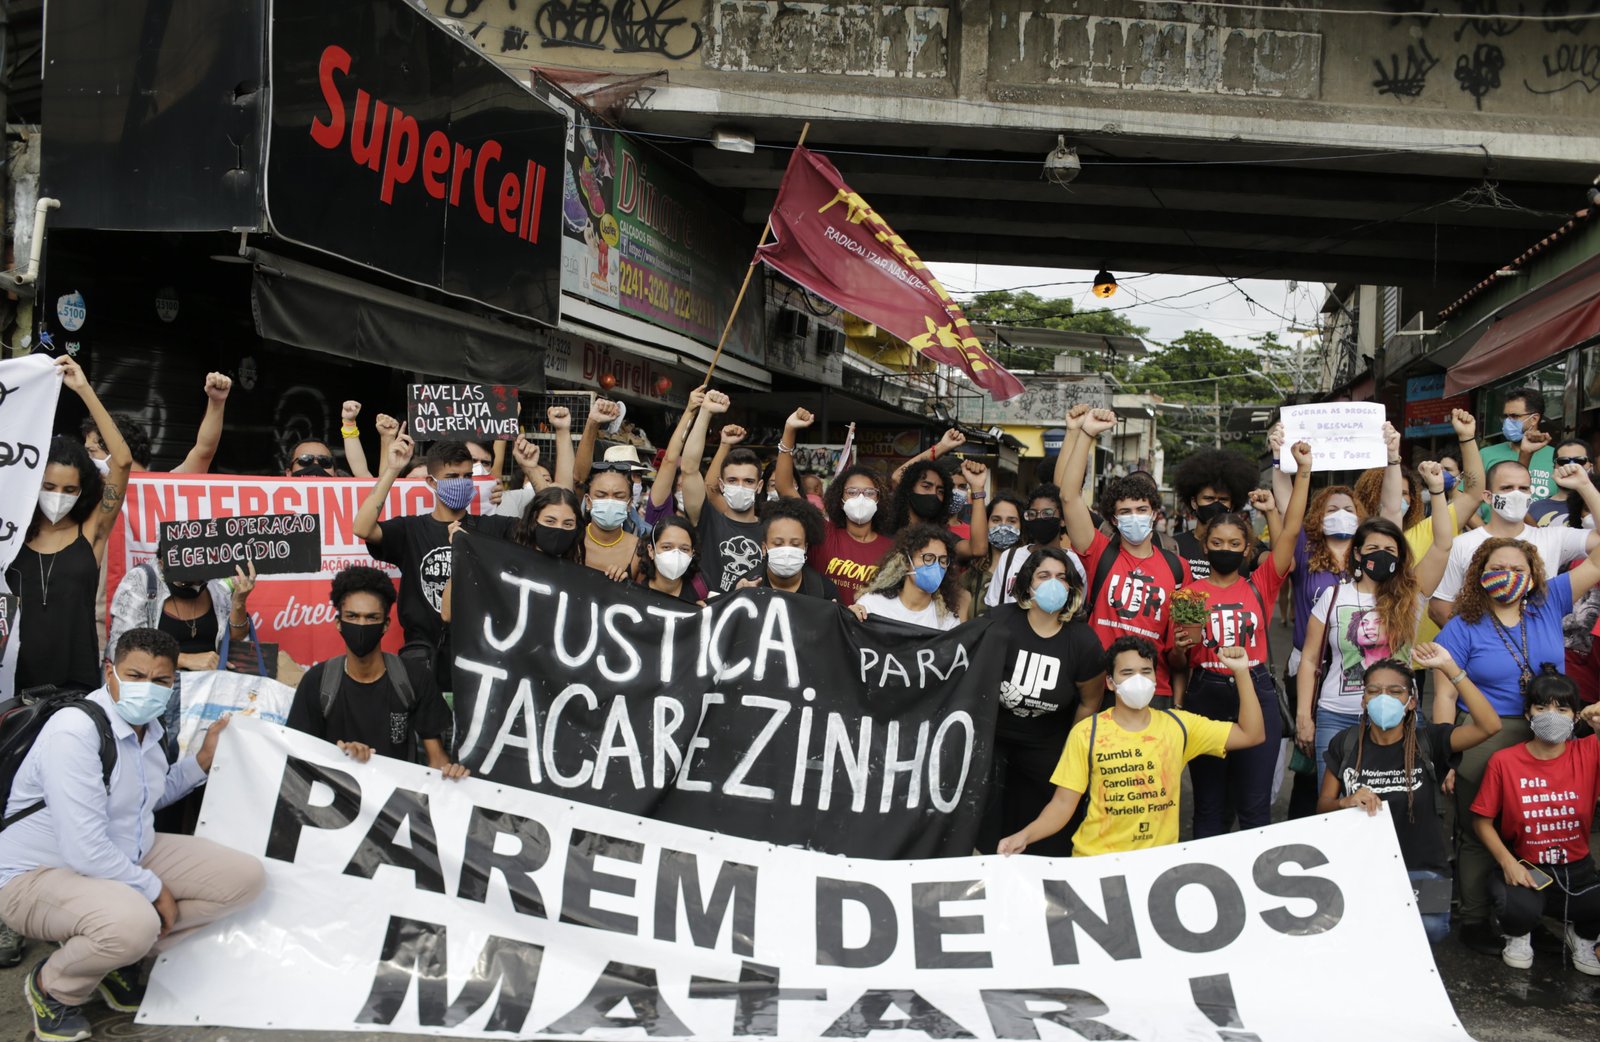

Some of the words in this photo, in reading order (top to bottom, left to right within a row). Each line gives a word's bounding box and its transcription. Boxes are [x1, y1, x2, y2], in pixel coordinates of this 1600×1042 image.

[310, 45, 546, 246] SuperCell
[824, 226, 888, 271] RADICALIZAR
[888, 262, 909, 280] NAS
[619, 261, 670, 312] 2241-3228
[413, 385, 484, 400] FAVELAS
[418, 402, 440, 415] NA
[453, 401, 492, 418] LUTA
[1291, 407, 1328, 417] GUERRA
[1330, 407, 1341, 415] AS
[415, 416, 477, 434] QUEREM
[480, 418, 519, 434] VIVER
[1533, 469, 1550, 478] TUDO
[167, 520, 202, 541] NÃO
[205, 518, 218, 538] É
[226, 514, 315, 536] OPERAÇÃO
[167, 545, 180, 567] É
[182, 538, 290, 568] GENOCÍDIO
[441, 561, 451, 577] FA
[860, 643, 970, 689] PARA
[1010, 649, 1061, 699] UP
[454, 655, 975, 814] JACAREZINHO
[1096, 749, 1132, 762] Zumbi
[1134, 749, 1142, 757] &
[1100, 763, 1144, 775] Dandara
[1147, 760, 1154, 770] &
[1361, 769, 1401, 777] Movimento
[1103, 777, 1145, 788] Carolina
[1147, 775, 1155, 784] &
[1520, 777, 1547, 788] Pela
[1103, 792, 1125, 802] Luiz
[1127, 790, 1158, 801] Gama
[1160, 787, 1166, 797] &
[1522, 791, 1579, 804] memória,
[1104, 805, 1145, 815] Marielle
[1523, 805, 1575, 818] verdade
[1525, 825, 1531, 833] e
[1536, 820, 1580, 834] justiça
[265, 754, 759, 957] PAREM
[815, 877, 994, 969] DE
[1042, 843, 1345, 966] NOS
